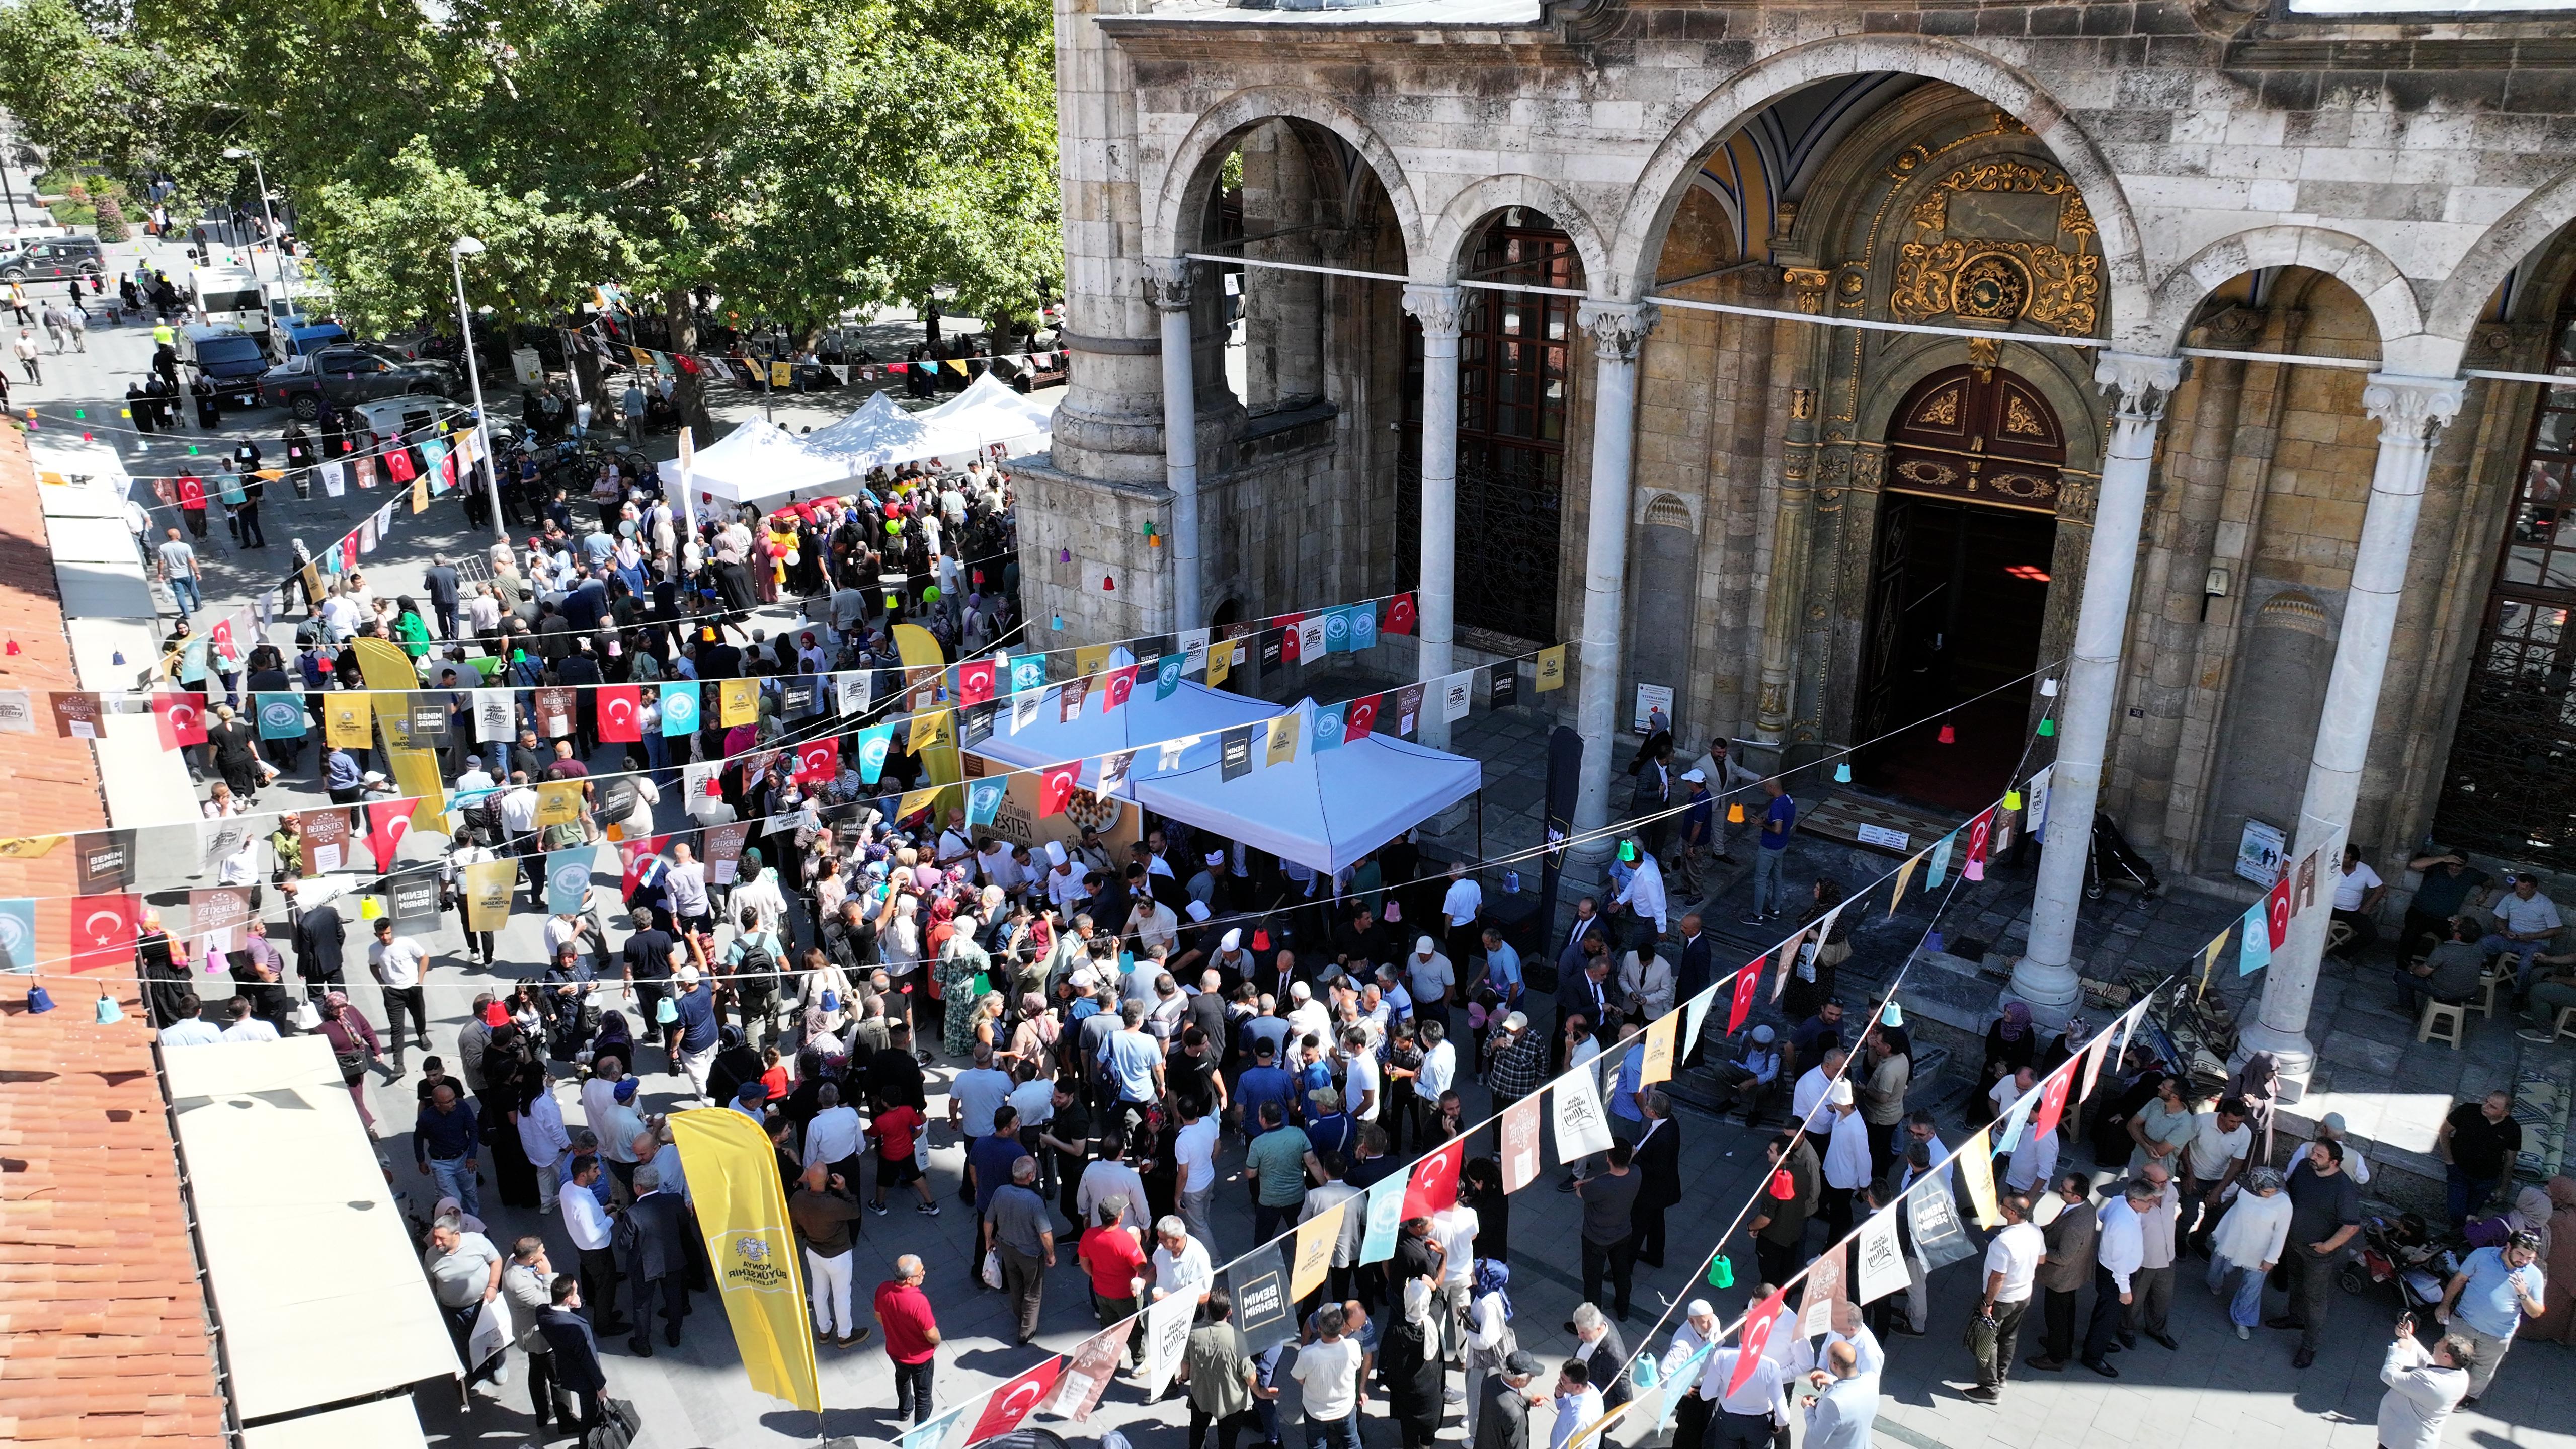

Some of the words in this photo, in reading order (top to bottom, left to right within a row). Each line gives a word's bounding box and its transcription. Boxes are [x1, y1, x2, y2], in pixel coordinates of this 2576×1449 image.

[1305, 635, 1321, 648] Altay
[1265, 644, 1278, 654] BENİM
[1141, 653, 1159, 662] BENİM
[788, 691, 809, 699] BENİM
[788, 695, 809, 704] ŞEHRİM
[484, 712, 507, 723] Altay
[608, 792, 631, 803] BENİM
[306, 822, 344, 834] BEDESTEN
[992, 814, 1033, 839] ESTEN
[91, 851, 123, 865] BENİM
[91, 858, 123, 872] ŞEHRİM
